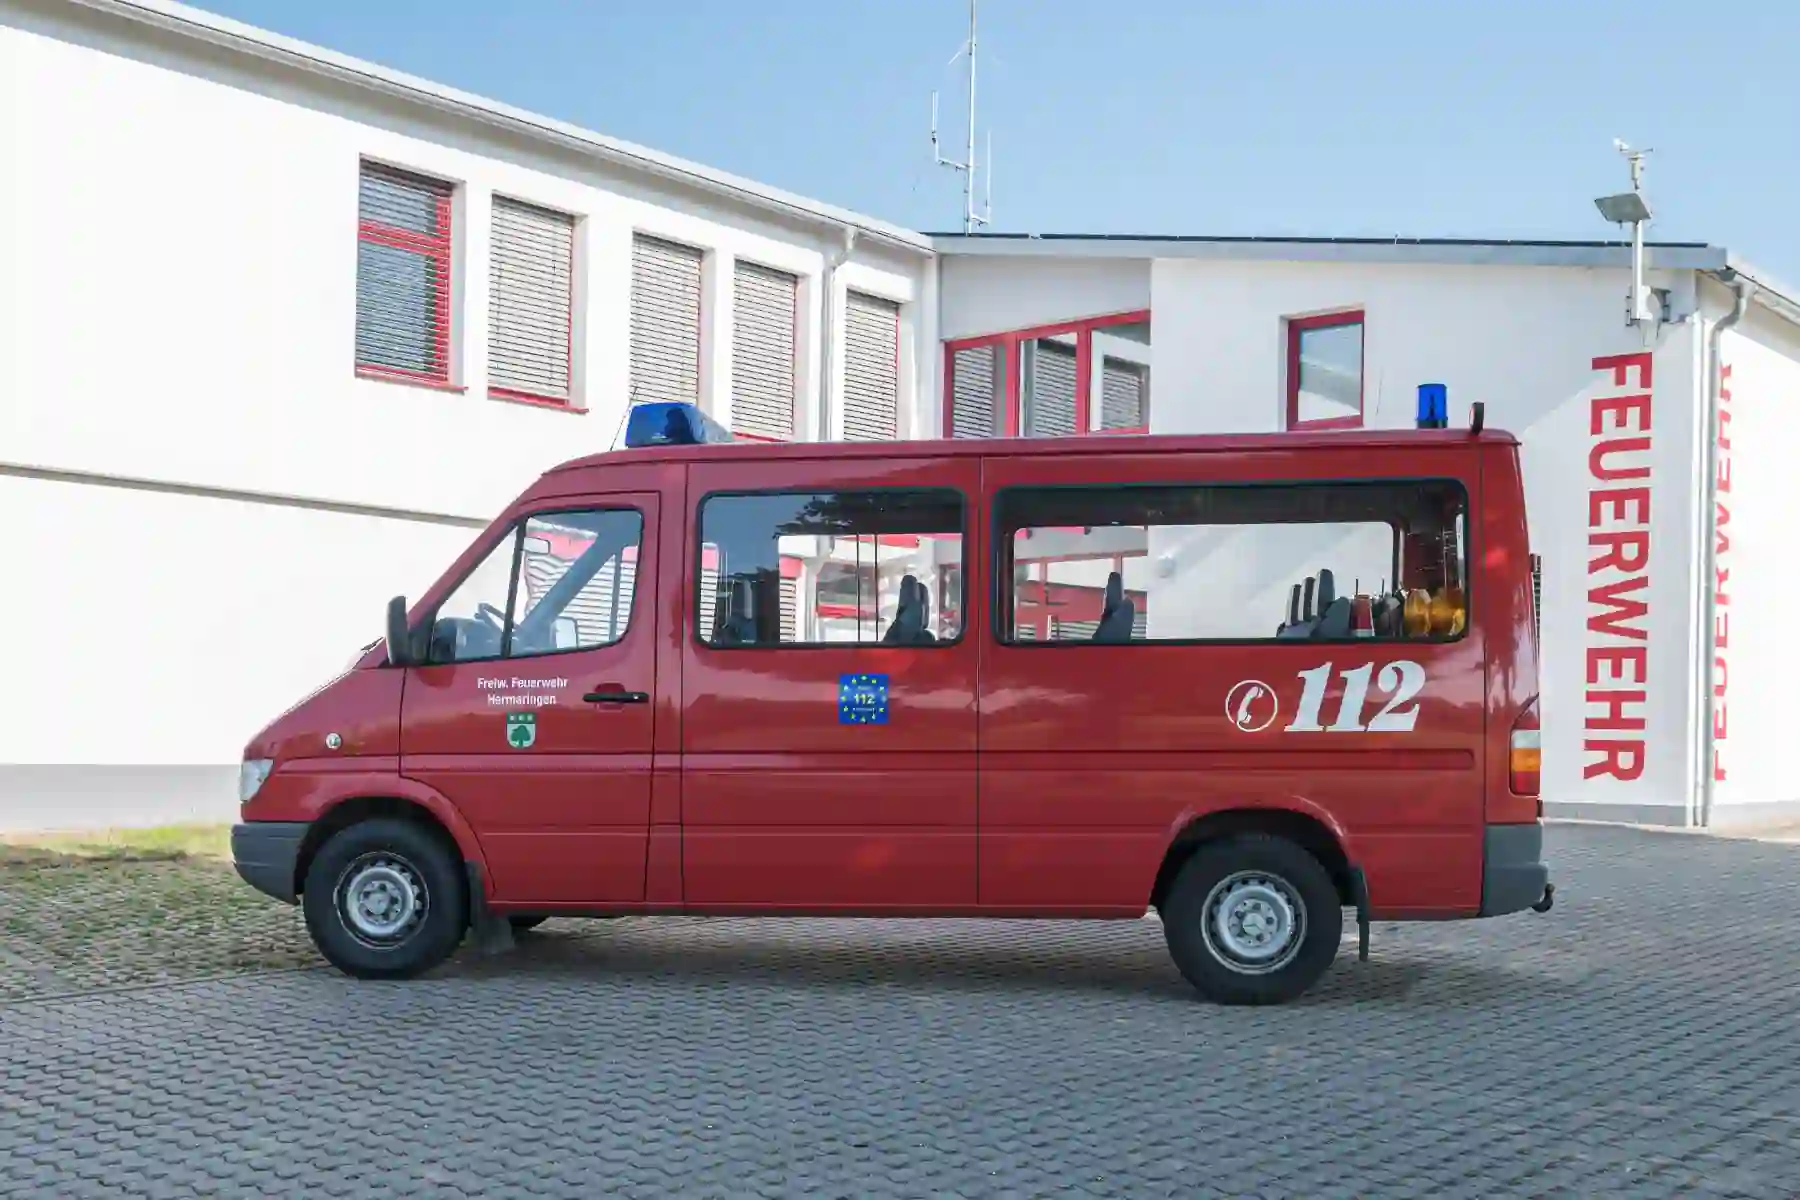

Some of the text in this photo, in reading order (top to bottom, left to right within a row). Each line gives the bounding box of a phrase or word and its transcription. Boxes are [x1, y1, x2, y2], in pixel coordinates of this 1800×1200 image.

[1583, 352, 1653, 781] FEUERWEHR
[511, 676, 569, 689] Feuerwehr
[487, 692, 557, 707] Hermaringen
[853, 693, 876, 704] 112
[1284, 660, 1426, 732] 112
